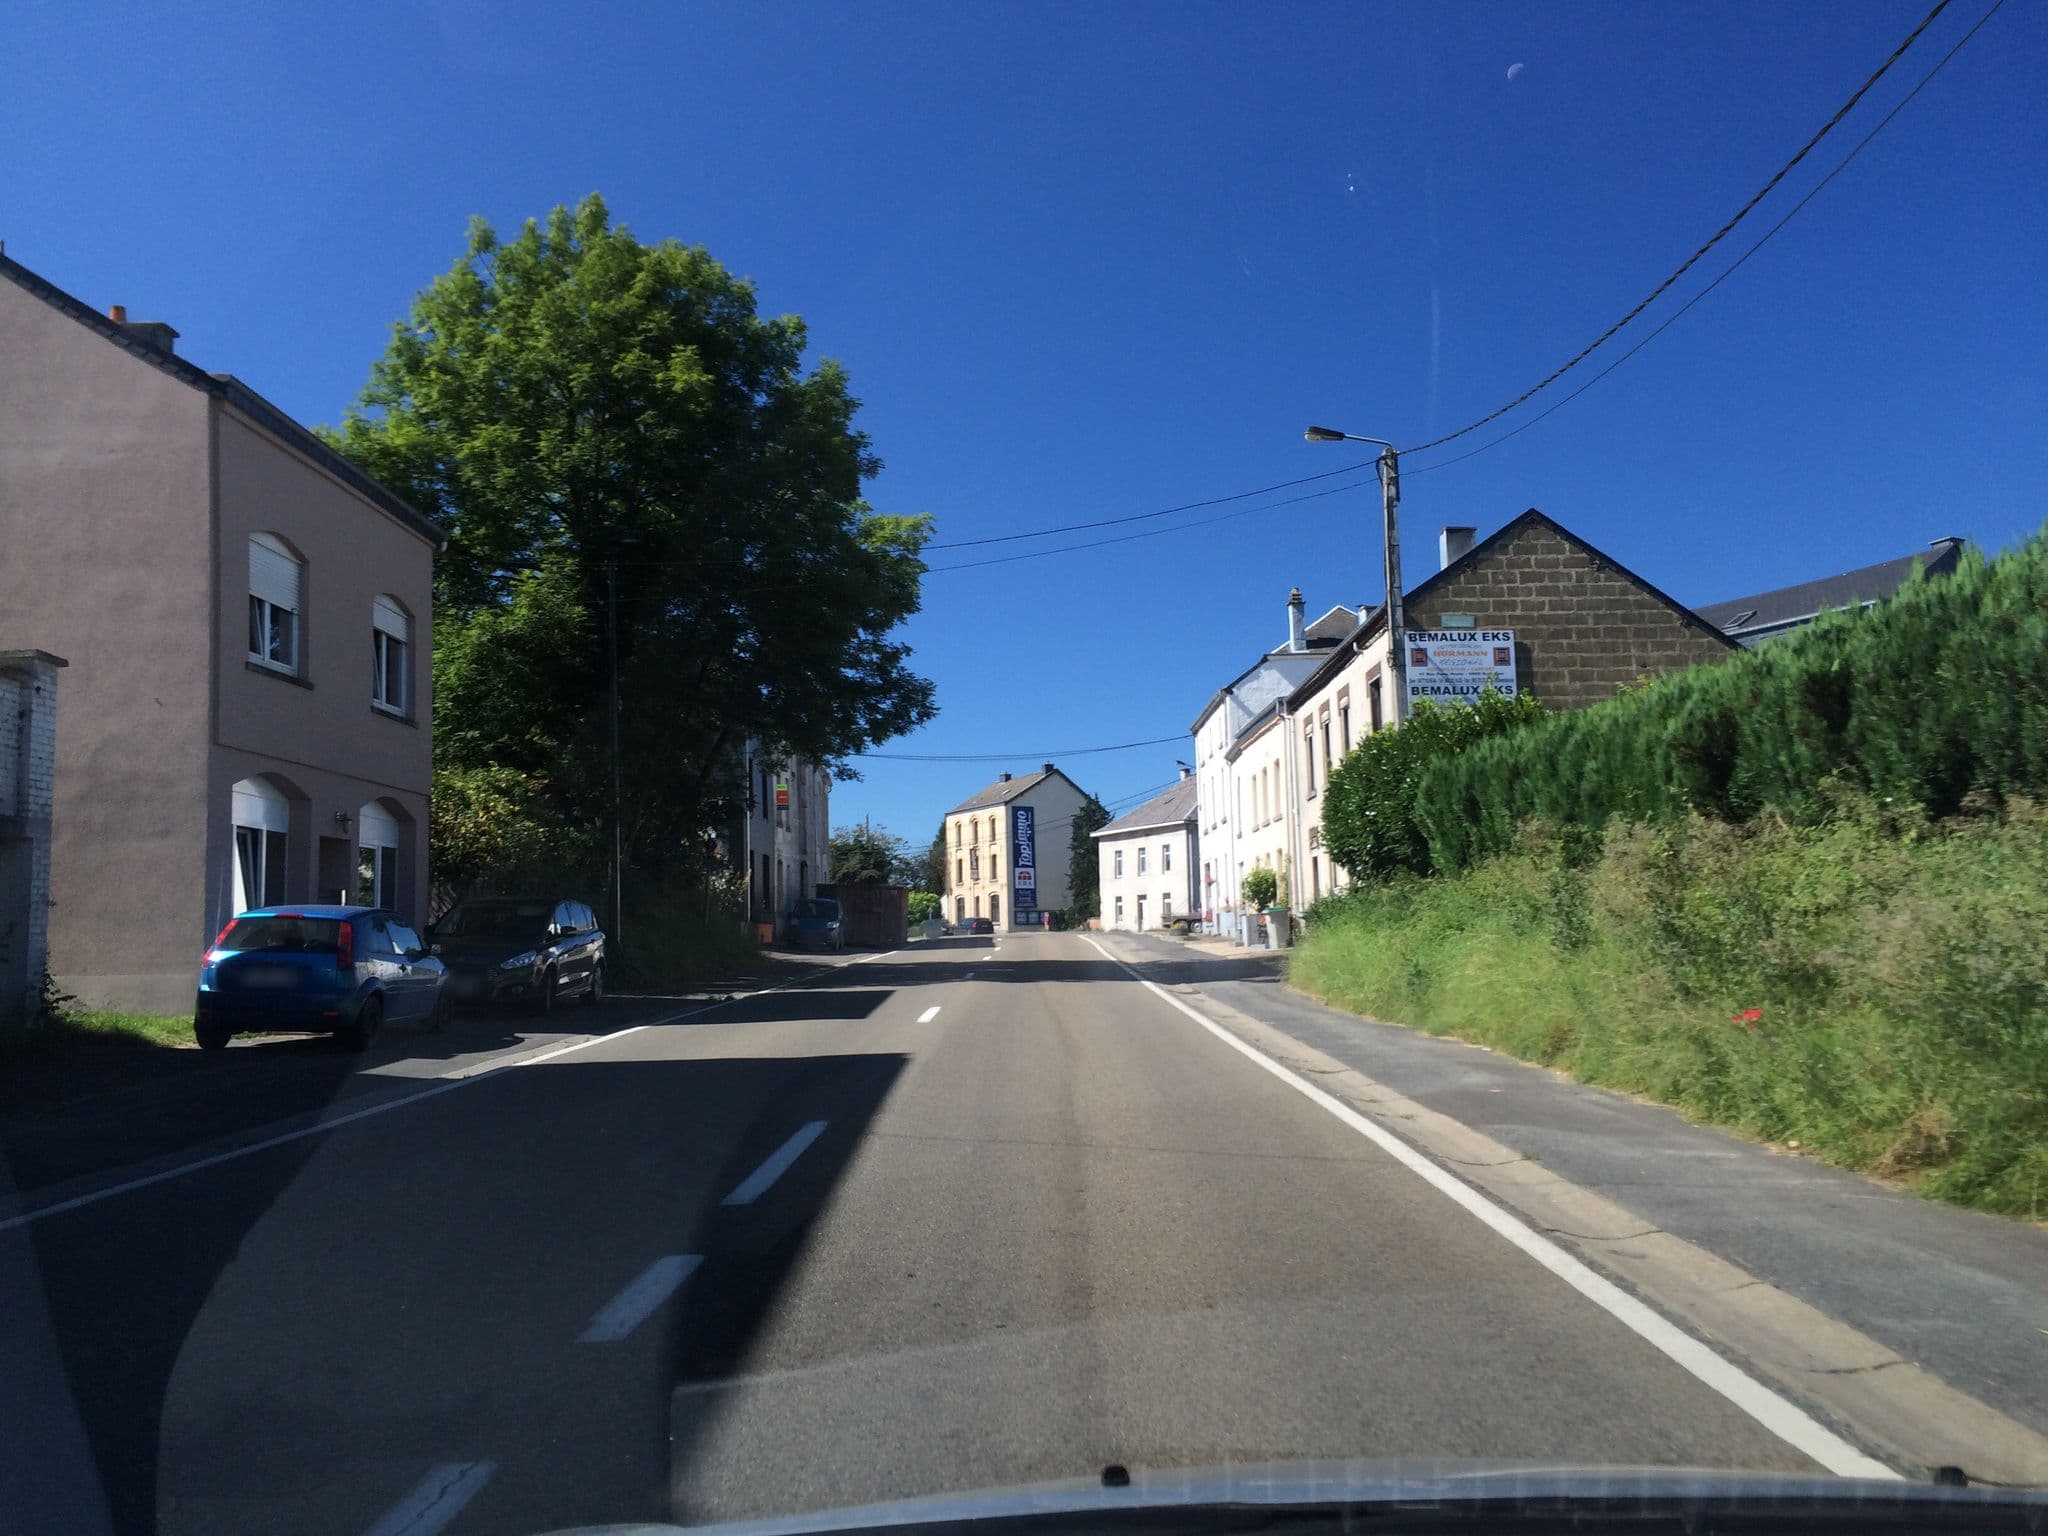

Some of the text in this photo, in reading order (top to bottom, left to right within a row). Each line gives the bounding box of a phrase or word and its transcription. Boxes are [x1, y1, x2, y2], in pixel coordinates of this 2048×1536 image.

[1409, 632, 1510, 642] BEMALUX EKS
[1412, 686, 1513, 695] BEMALUX KS
